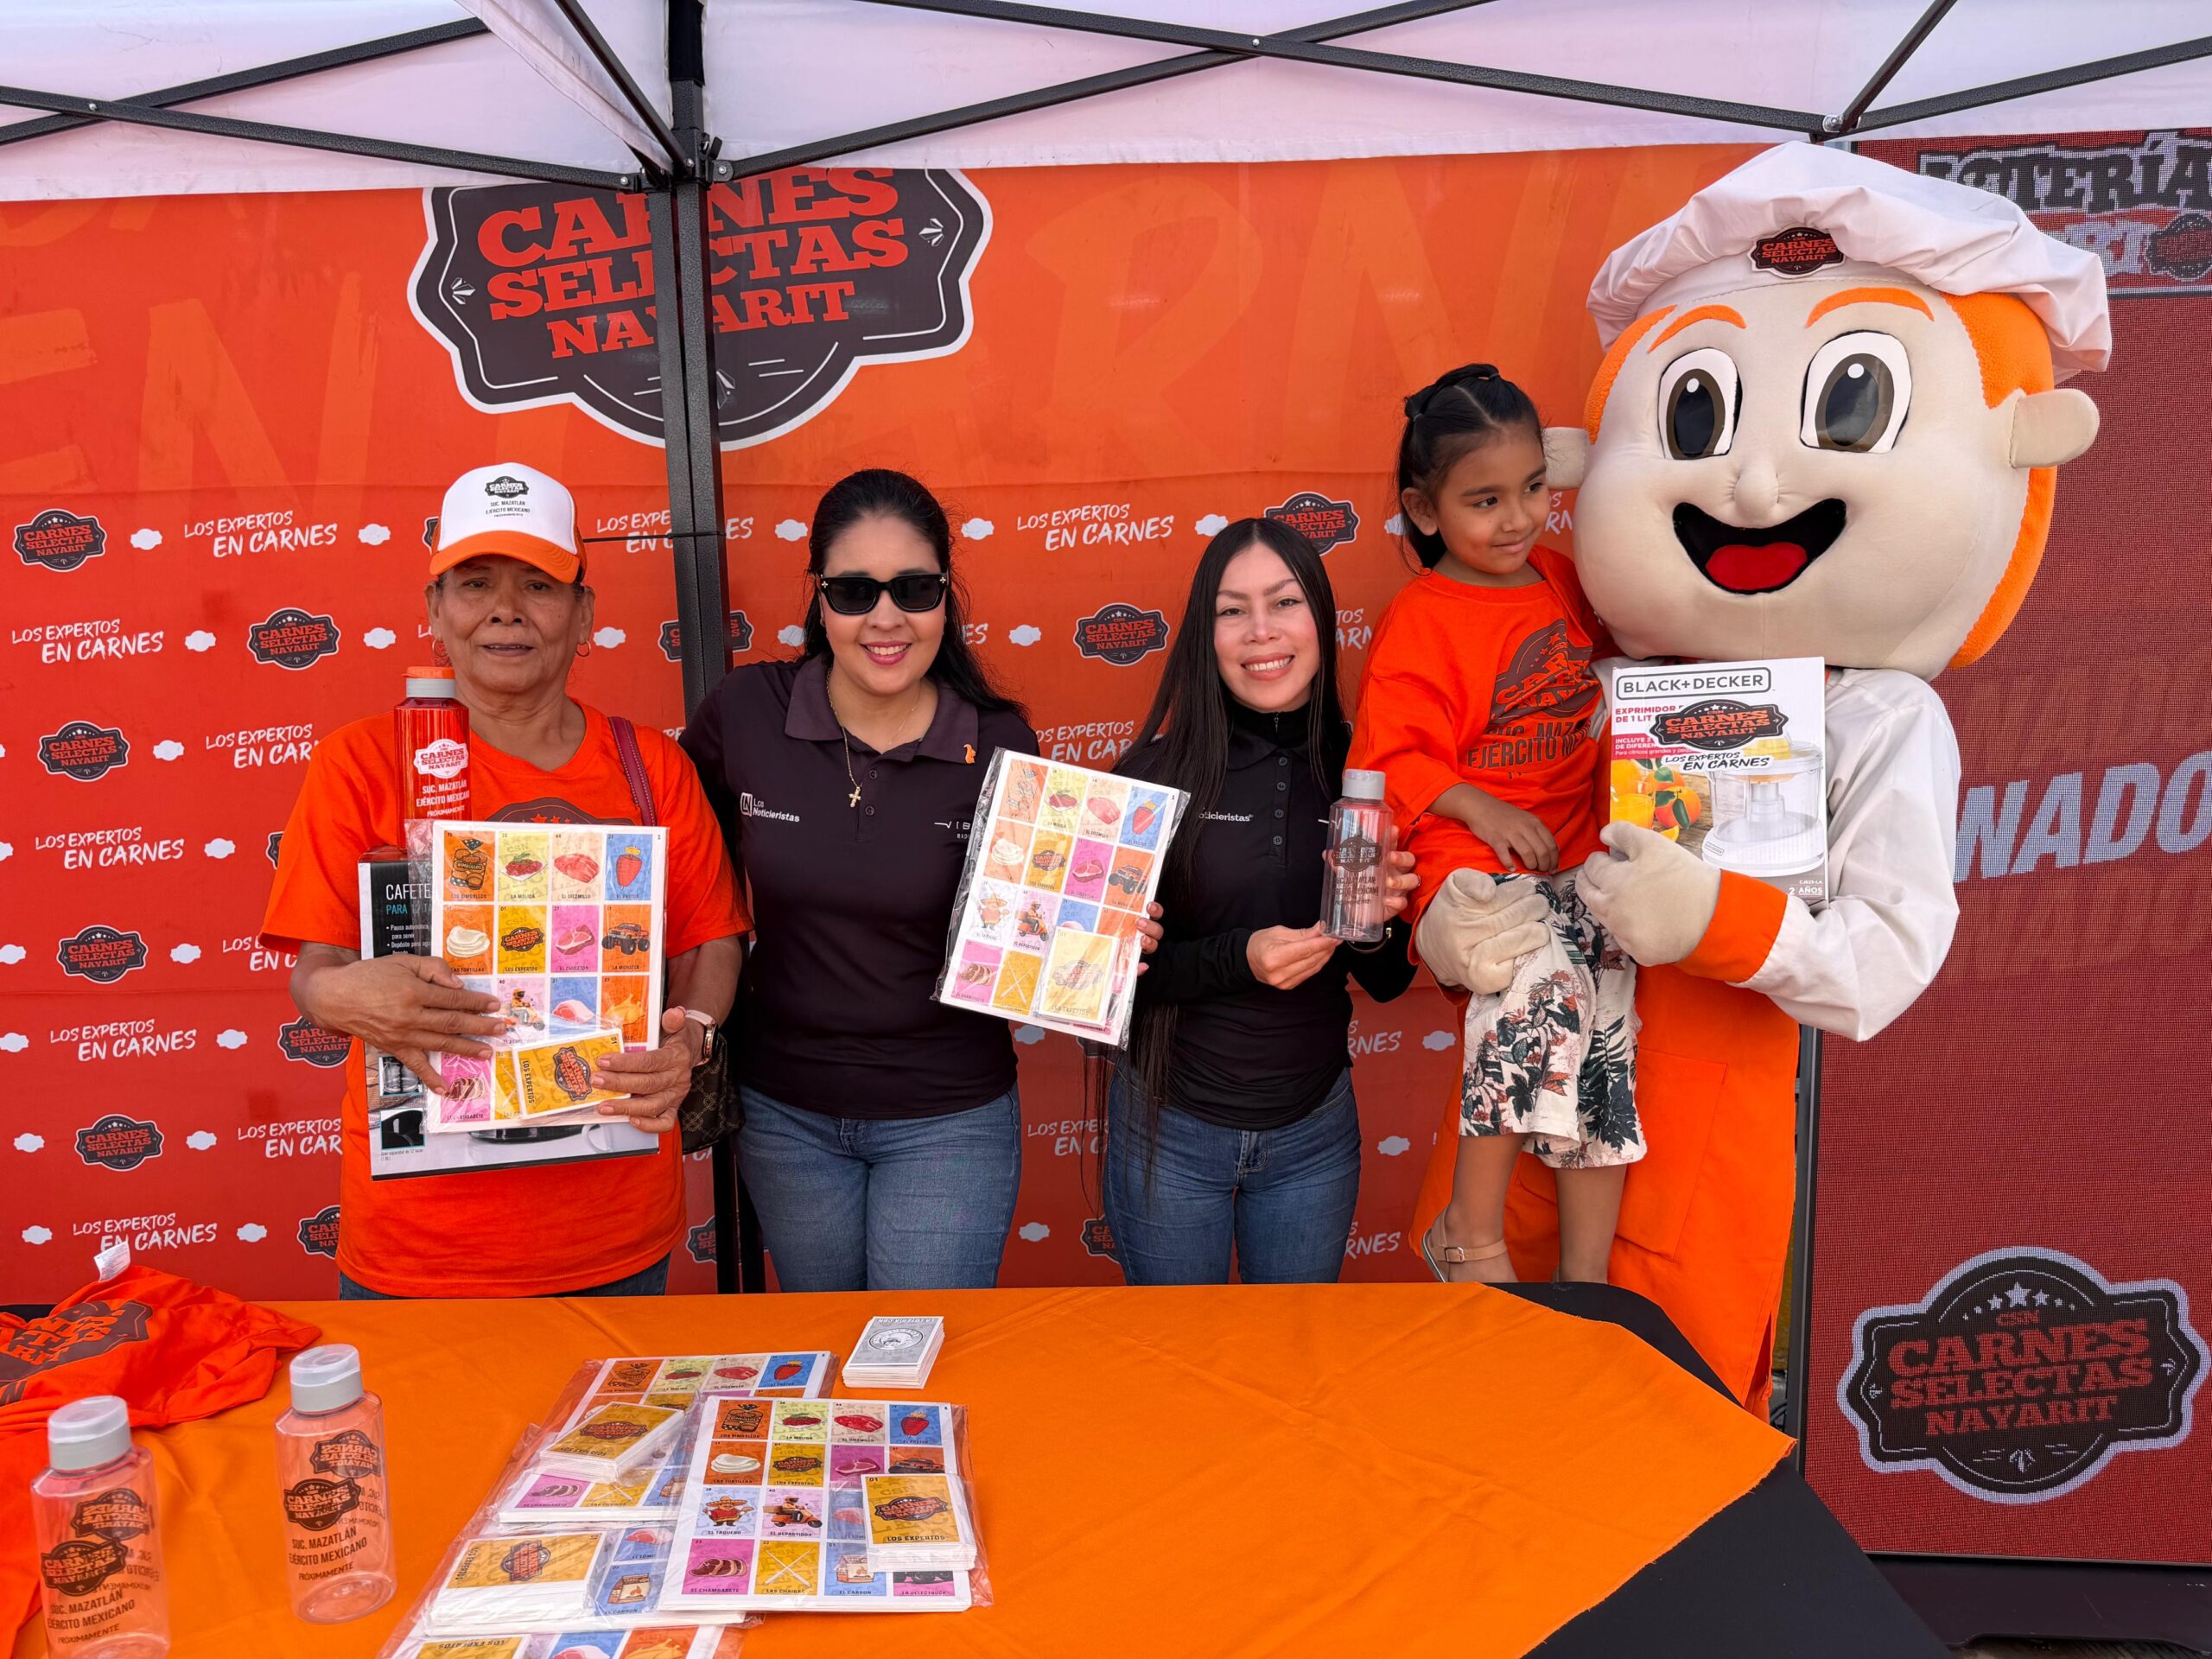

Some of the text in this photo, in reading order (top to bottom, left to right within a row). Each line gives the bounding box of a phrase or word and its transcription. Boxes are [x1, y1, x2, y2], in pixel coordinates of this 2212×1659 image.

[1763, 238, 1835, 251] CARNES
[1763, 247, 1836, 257] SELECTAS
[1771, 254, 1826, 263] NAYARIT
[547, 281, 855, 359] NAARIT
[184, 511, 293, 537] LOS EXPERTOS
[597, 515, 627, 532] LOS
[1017, 503, 1130, 531] LOS EXPERTOS
[24, 524, 91, 540] CARNES
[213, 523, 337, 557] EN CARNES
[1046, 516, 1174, 551] EN CARNES
[26, 535, 93, 550] SELECTAS
[36, 543, 86, 556] NAYARIT
[626, 531, 657, 553] EN
[11, 619, 120, 644] LOS EXPERTOS
[258, 623, 325, 639] CARNES
[1085, 619, 1154, 635] CARNES
[1087, 626, 1156, 643] SELECTAS
[42, 631, 164, 664] EN CARNES
[260, 632, 327, 648] SELECTAS
[270, 642, 320, 655] NAYARIT
[1096, 637, 1148, 650] NAYARIT
[1624, 675, 1764, 693] BLACK+DECKER
[1616, 706, 1675, 715] EXPRIMIDOR
[1665, 710, 1769, 726] CARNES
[1057, 721, 1134, 741] EXPERTOS
[1667, 718, 1770, 734] SELECTAS
[1681, 728, 1757, 739] NAYARIT
[48, 736, 115, 752] CARNES
[206, 724, 313, 749] LOS EXPERTOS
[51, 745, 117, 760] SELECTAS
[61, 754, 109, 767] NAYARIT
[234, 747, 263, 768] EN
[421, 748, 464, 760] CARNES
[422, 754, 465, 766] SELECTAS
[1052, 743, 1080, 763] EN
[1467, 735, 1554, 770] EJÉRCITO
[1688, 752, 1740, 762] EXPERTOS
[1683, 757, 1770, 771] EN CARNES
[423, 785, 437, 794] SUC.
[416, 795, 446, 807] EJÉRCITO
[753, 807, 800, 823] Noticieristas
[1198, 811, 1250, 822] oticieristas
[1953, 750, 2212, 884] NADO
[35, 827, 142, 850] LOS EXPERTOS
[64, 839, 184, 870] EN CARNES
[386, 904, 408, 914] PARA
[67, 939, 133, 954] CARNES
[222, 937, 251, 953] LOS
[69, 948, 136, 963] SELECTAS
[79, 957, 127, 969] NAYARIT
[250, 950, 278, 972] EN
[50, 1020, 155, 1043] LOS EXPERTOS
[78, 1030, 197, 1061] EN CARNES
[1348, 1032, 1402, 1059] RNES
[524, 1074, 535, 1103] EXPERTOS
[86, 1128, 149, 1145] CARNES
[238, 1118, 341, 1141] LOS EXPERTOS
[1027, 1122, 1056, 1137] LOS
[87, 1136, 151, 1152] SELECTAS
[97, 1145, 144, 1158] NAYARIT
[265, 1139, 294, 1159] EN
[1054, 1137, 1082, 1156] EN
[73, 1213, 176, 1236] LOS EXPERTOS
[135, 1223, 217, 1251] CARNES
[1345, 1232, 1401, 1259] RNES
[1995, 1310, 2040, 1327] CSN
[1888, 1319, 2151, 1377] CARNES
[1891, 1357, 2153, 1409] SELECTAS
[1924, 1395, 2118, 1436] NAYARIT
[287, 1484, 349, 1504] CARNES
[289, 1493, 351, 1512] SELECTAS
[292, 1526, 357, 1549] SUC. MAZATLÁN
[44, 1546, 115, 1569] CARNES
[321, 1537, 367, 1563] MEXICANO
[46, 1555, 117, 1577] SELECTAS
[299, 1562, 354, 1580] PRÓXIMAMENTE
[51, 1590, 123, 1615] SUC. MAZATLÁN
[82, 1599, 135, 1627] MEXICANO
[58, 1624, 119, 1643] PRÓXIMAMENTE
